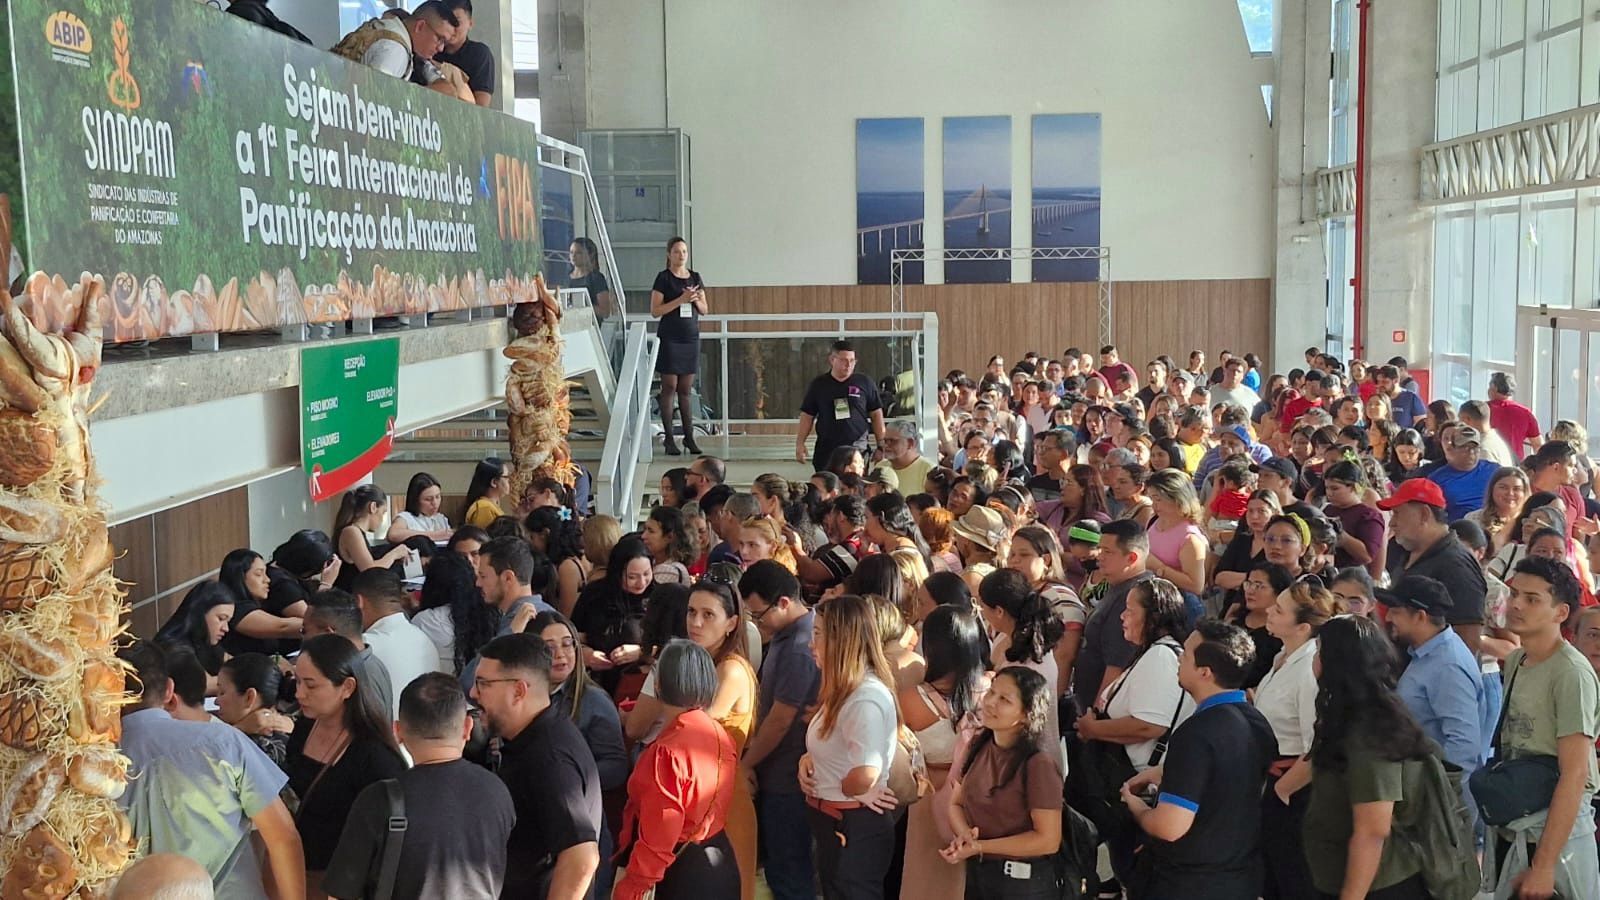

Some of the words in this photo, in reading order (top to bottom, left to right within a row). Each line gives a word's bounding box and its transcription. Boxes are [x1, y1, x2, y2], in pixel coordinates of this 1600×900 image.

[53, 20, 86, 48] ABIP
[283, 62, 353, 144] Sejam
[353, 84, 442, 152] bem-vindo
[82, 106, 176, 178] SINDPAM
[235, 129, 256, 175] a
[285, 128, 342, 189] Feira
[344, 141, 455, 204] Internacional
[455, 165, 473, 206] de
[88, 183, 123, 201] SINDICATO
[124, 186, 137, 202] DAS
[137, 187, 169, 205] INDÚSTRIAS
[170, 191, 179, 206] DE
[90, 204, 135, 225] PANIFICAÇÃO
[136, 208, 141, 224] E
[141, 209, 180, 226] CONFEITARIA
[494, 152, 537, 242] FIPA
[115, 228, 126, 244] DO
[127, 229, 163, 245] AMAZONAS
[239, 186, 377, 265] Panificação
[380, 203, 405, 250] da
[406, 206, 478, 253] Amazônia
[310, 400, 321, 414] PISO
